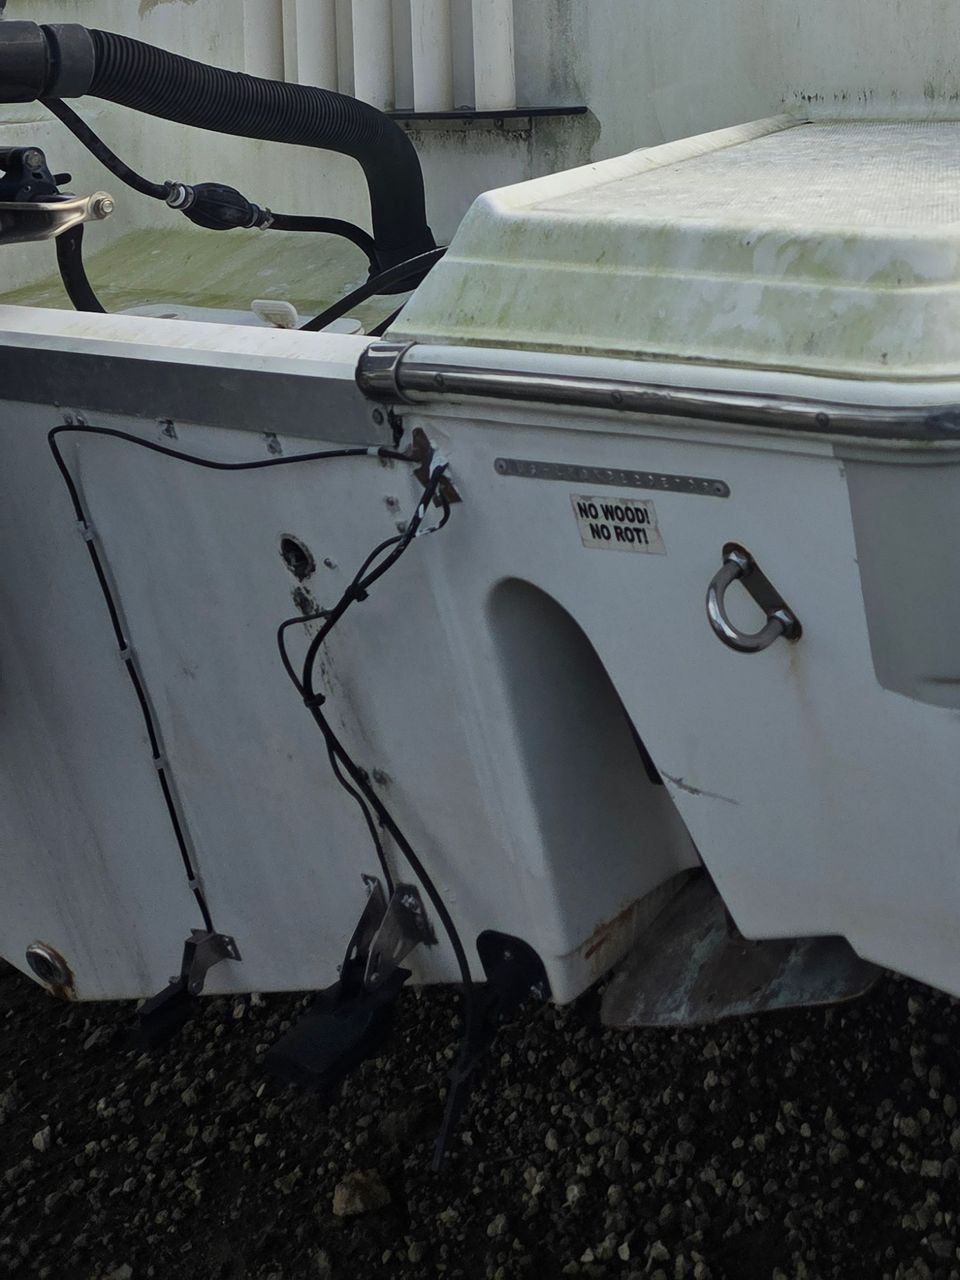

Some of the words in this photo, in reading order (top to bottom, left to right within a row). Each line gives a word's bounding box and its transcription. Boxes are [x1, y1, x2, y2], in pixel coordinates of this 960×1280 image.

[577, 502, 599, 520] NO
[600, 504, 651, 525] WOOD!
[589, 522, 611, 541] NO
[613, 525, 649, 545] ROT!
